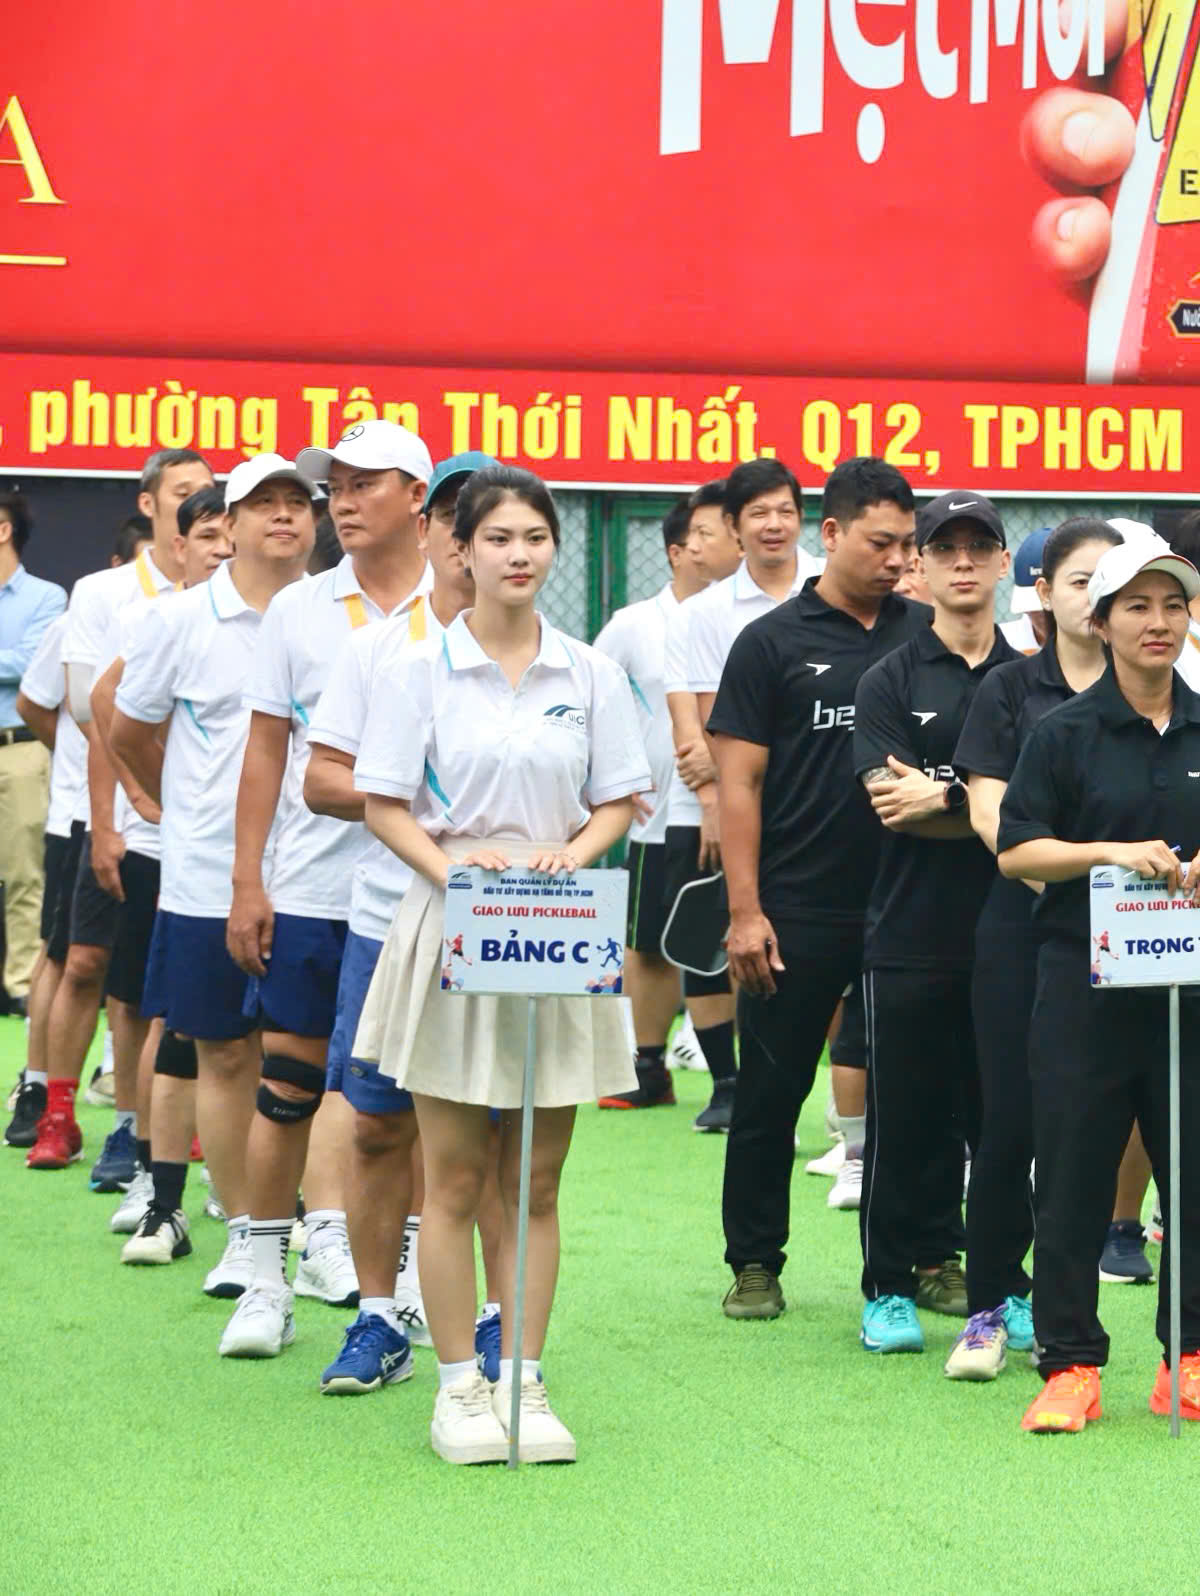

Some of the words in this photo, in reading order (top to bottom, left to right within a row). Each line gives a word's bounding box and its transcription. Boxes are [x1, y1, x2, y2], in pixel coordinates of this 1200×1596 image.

[30, 379, 278, 457] phường
[444, 392, 583, 460] Thới
[803, 401, 940, 475] Q12,
[965, 405, 1183, 472] TPHCM
[472, 905, 503, 917] GIAO
[507, 906, 530, 918] LƯU
[533, 906, 597, 919] PICKLEBALL
[1115, 902, 1144, 913] GIAO
[1147, 899, 1169, 911] LƯU
[480, 929, 566, 963] BẢNG
[572, 940, 590, 964] C
[1125, 936, 1194, 960] TRỌNG
